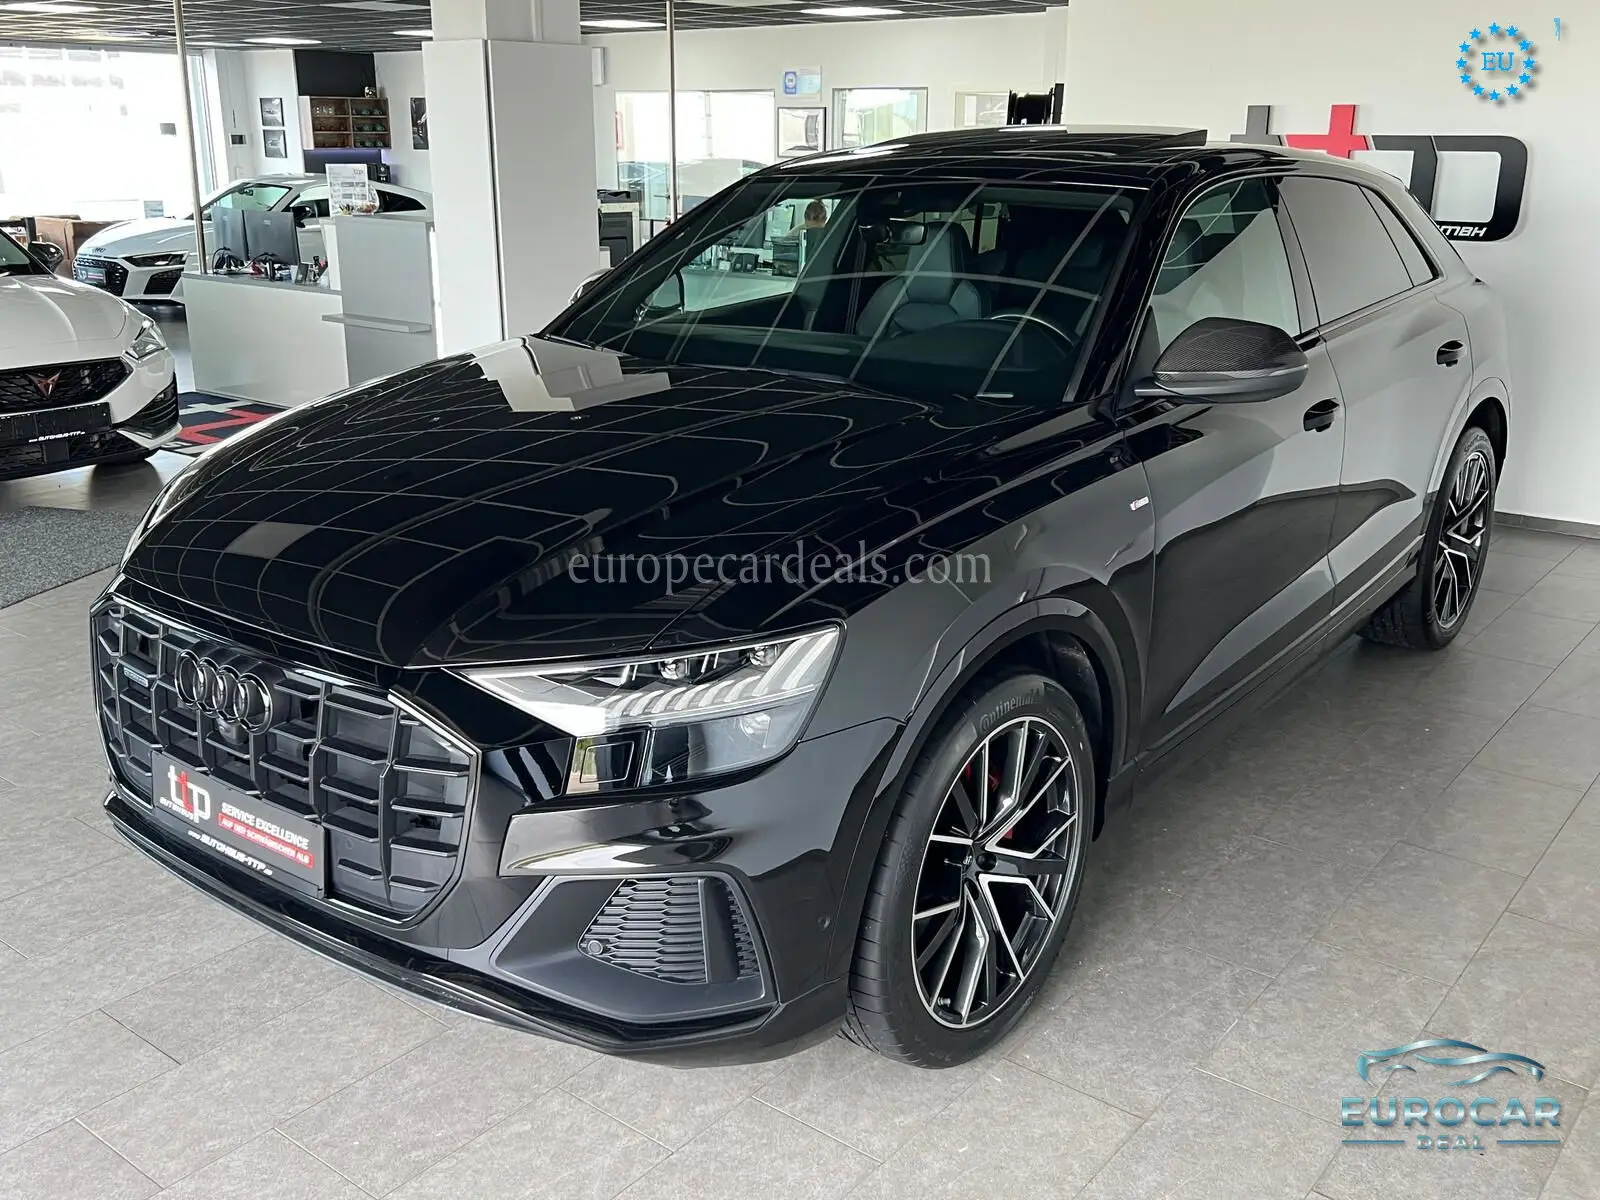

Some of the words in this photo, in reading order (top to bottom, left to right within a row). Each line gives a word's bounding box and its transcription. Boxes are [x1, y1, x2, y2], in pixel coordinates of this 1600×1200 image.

[1437, 225, 1488, 237] MBH
[221, 801, 256, 825] SERVICE
[255, 817, 310, 850] EXCELLENCE
